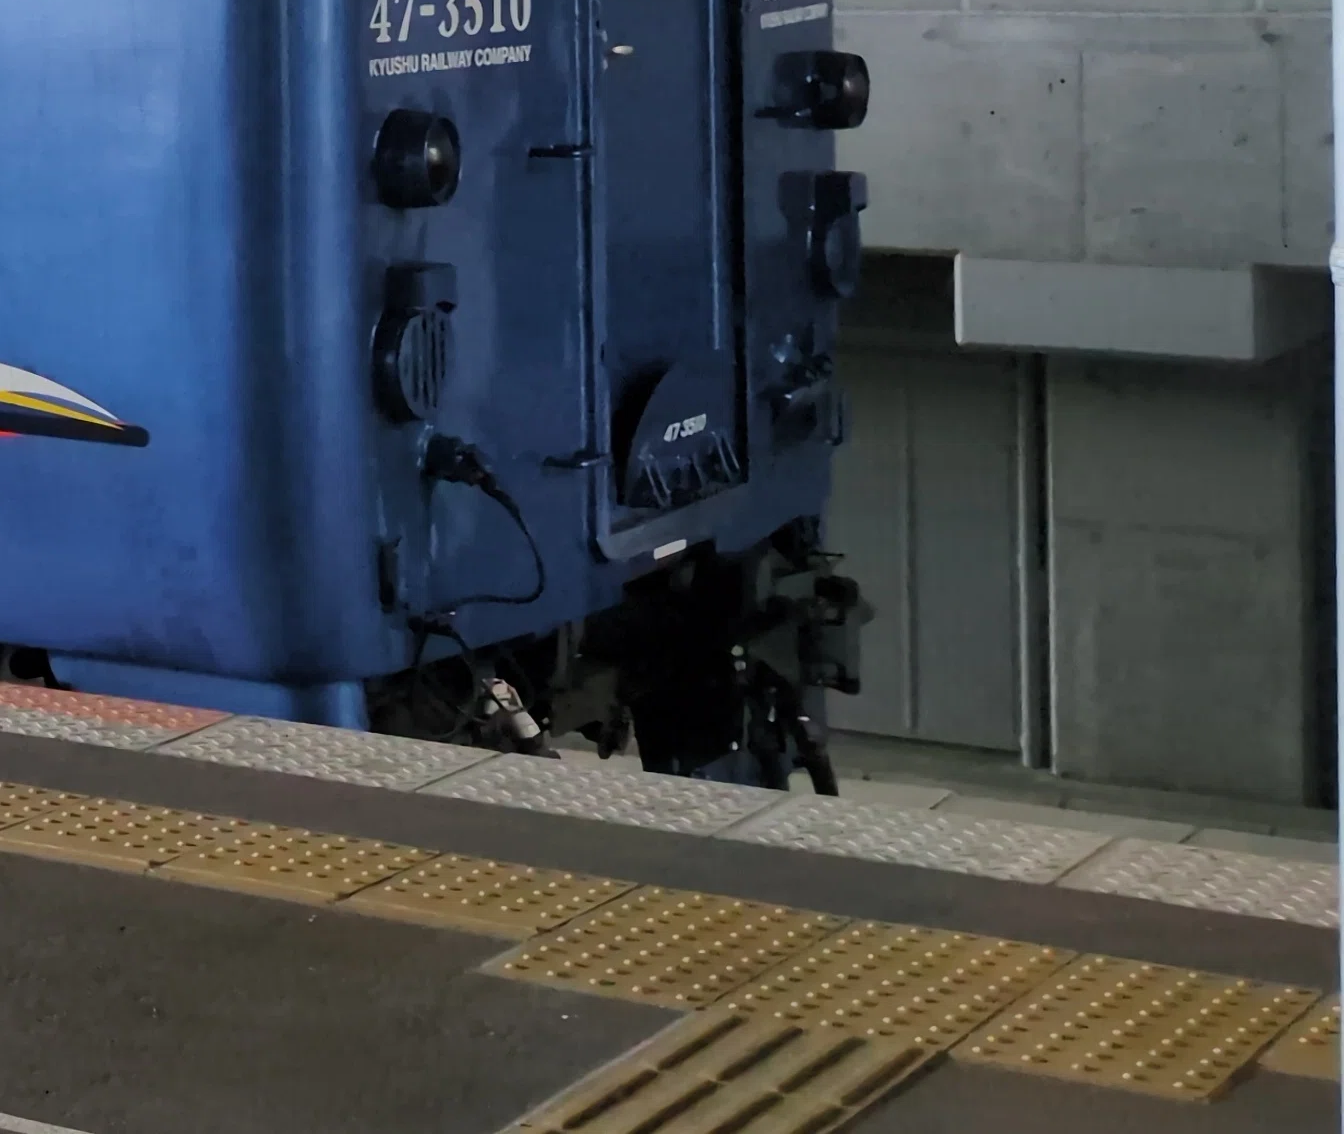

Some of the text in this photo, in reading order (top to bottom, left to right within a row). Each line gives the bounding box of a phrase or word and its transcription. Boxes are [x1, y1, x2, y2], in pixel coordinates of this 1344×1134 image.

[369, 45, 532, 77] KYUSHU RAILWAY COMPANY
